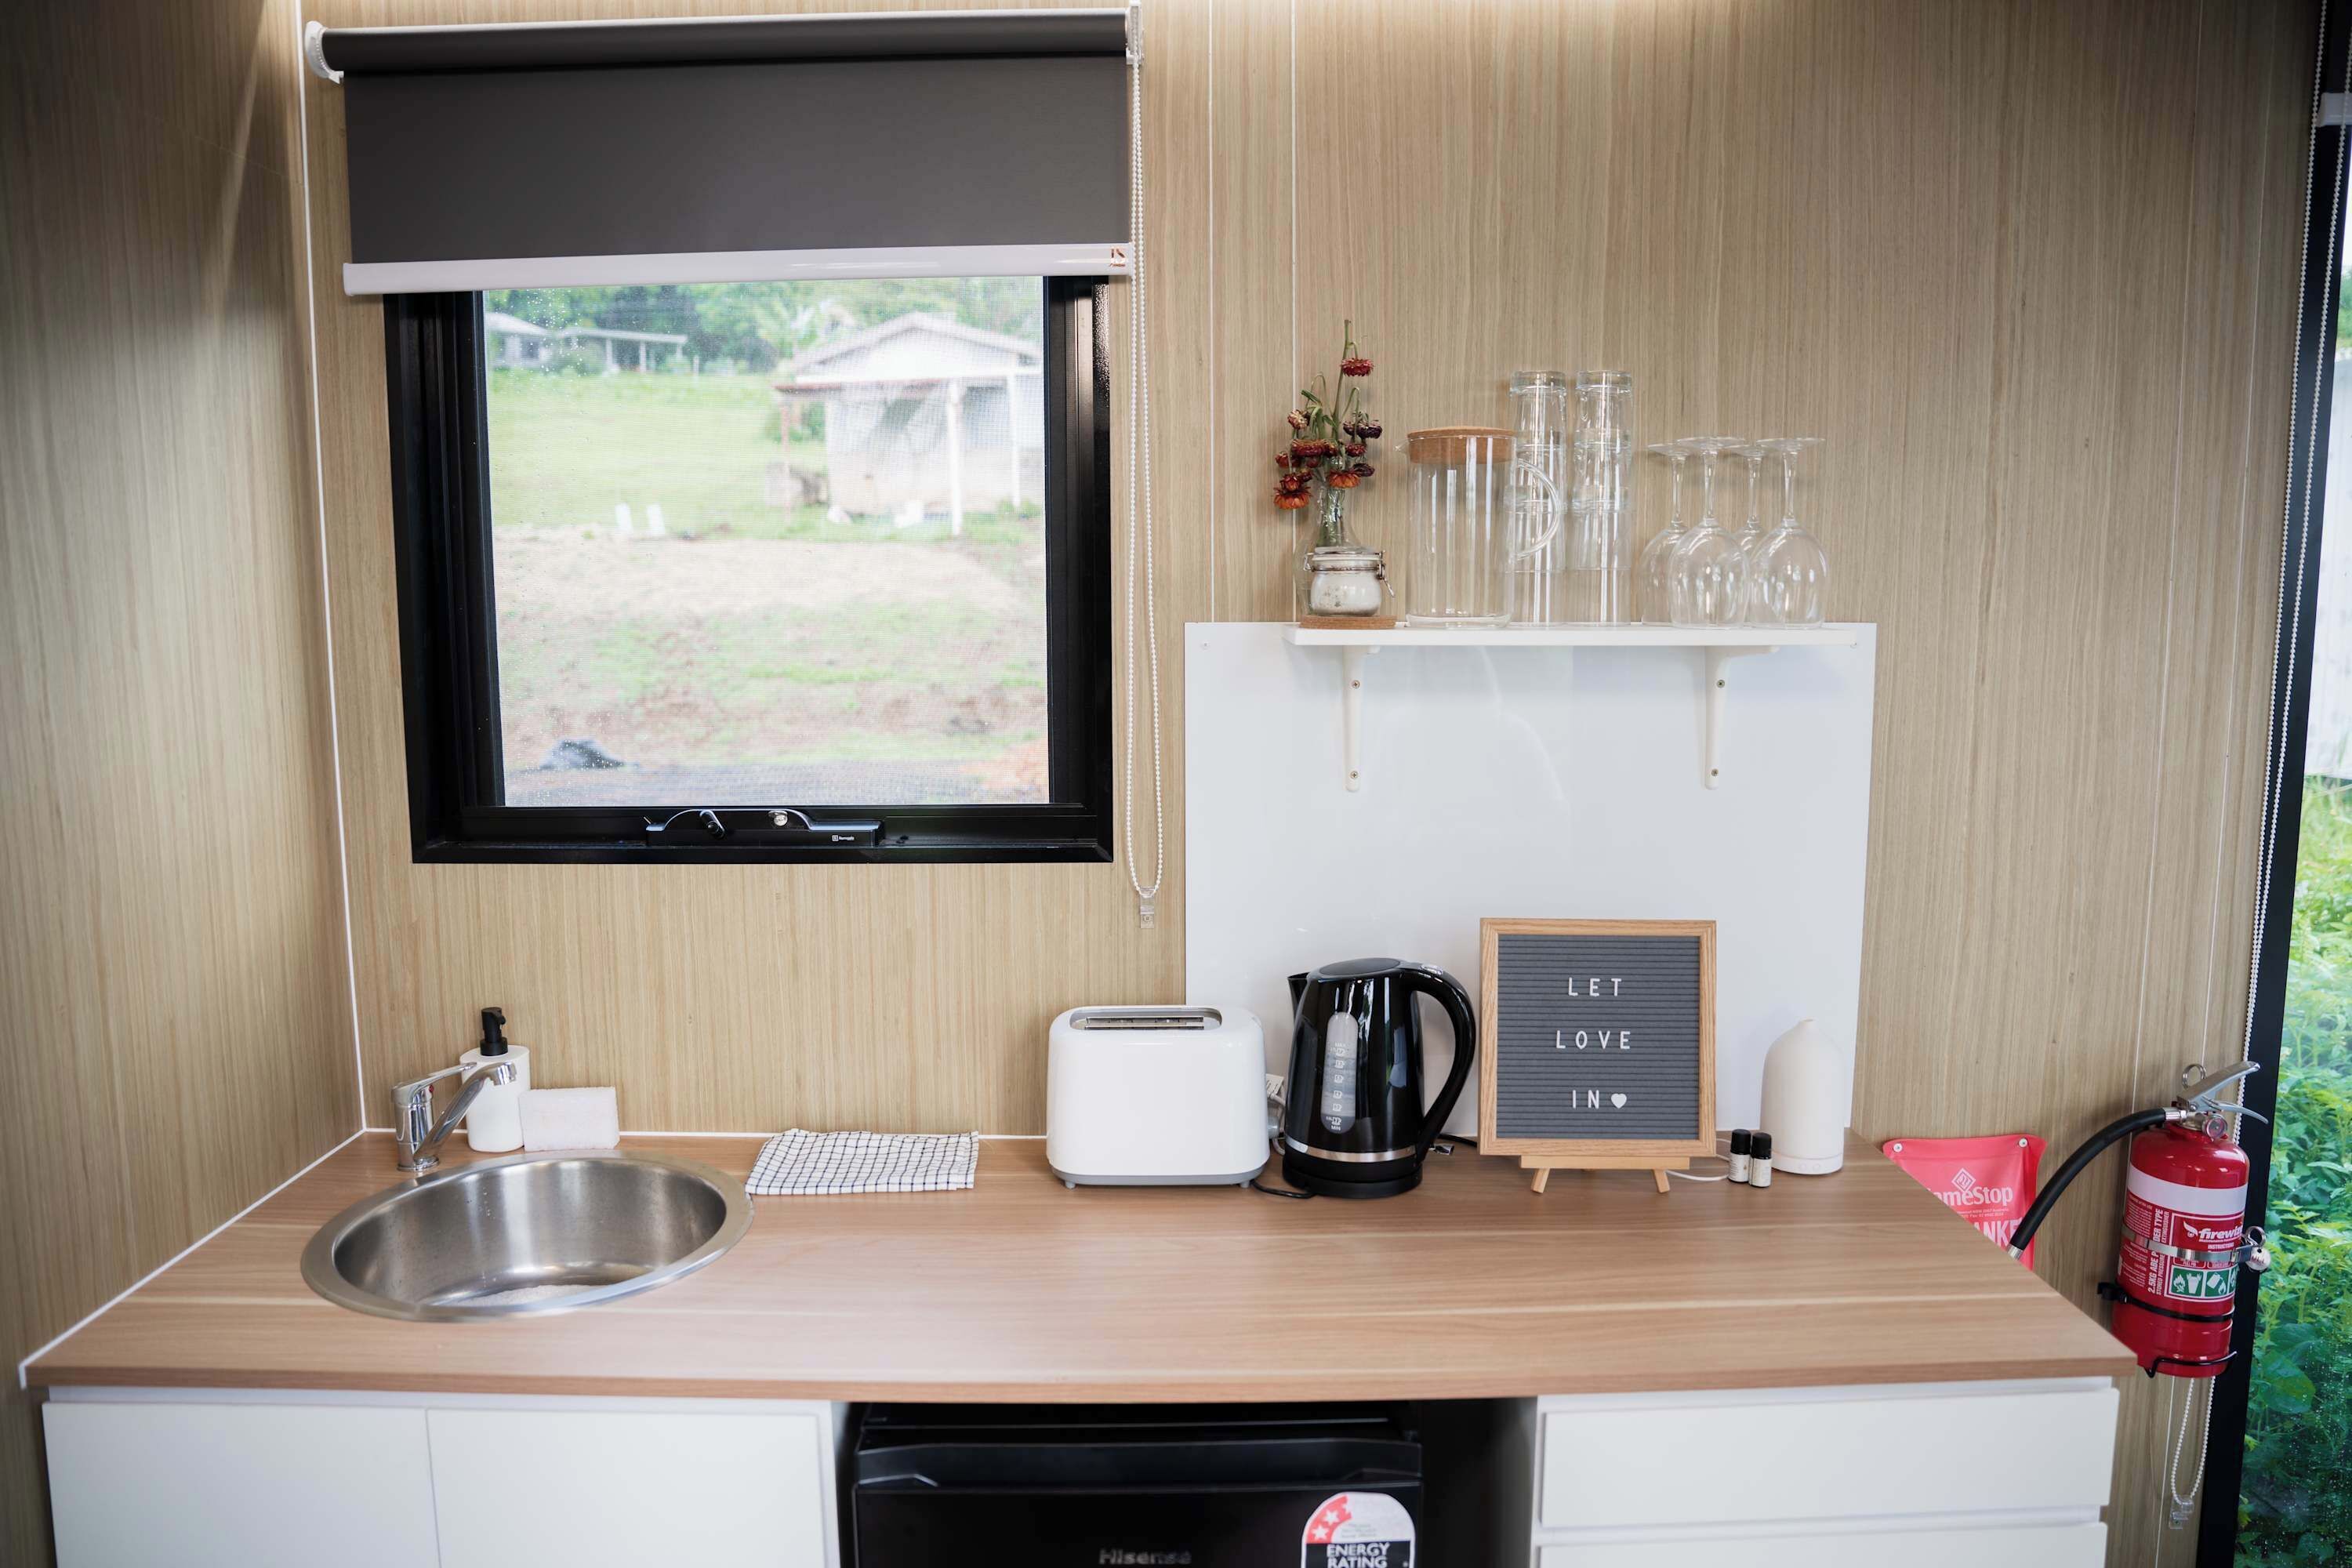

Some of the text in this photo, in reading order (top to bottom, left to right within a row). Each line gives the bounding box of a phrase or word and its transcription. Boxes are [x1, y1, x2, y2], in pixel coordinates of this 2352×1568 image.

[1568, 977, 1622, 997] LET
[1555, 1029, 1631, 1050] LOVE
[1572, 1089, 1600, 1109] IN
[2154, 1208, 2164, 1227] TYPE
[2150, 1258, 2159, 1272] ABE
[2147, 1272, 2158, 1294] 2.5KG
[1098, 1548, 1192, 1565] Hisense
[1327, 1541, 1390, 1558] ENERGY
[1327, 1555, 1388, 1568] RATING
